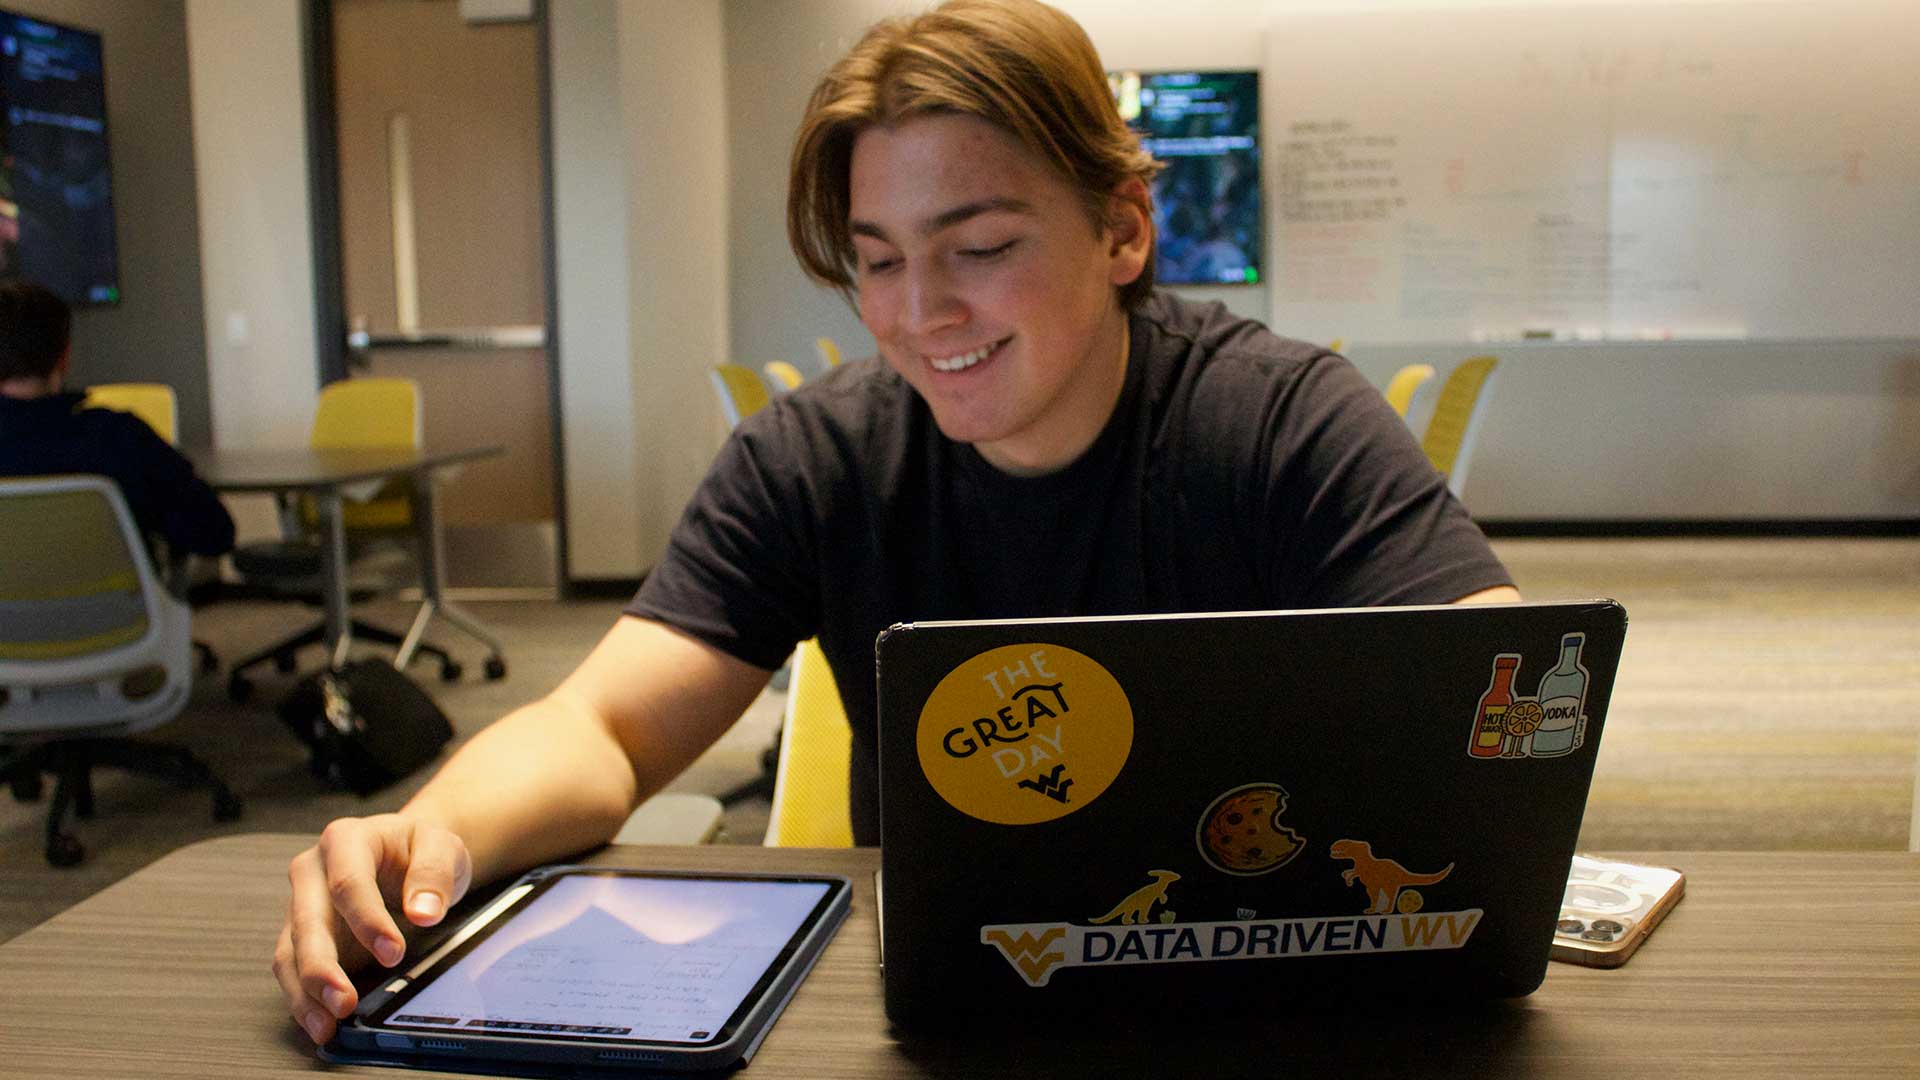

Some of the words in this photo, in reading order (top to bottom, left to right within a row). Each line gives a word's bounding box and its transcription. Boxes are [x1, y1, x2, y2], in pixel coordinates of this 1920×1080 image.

[983, 651, 1056, 699] THE
[943, 682, 1069, 758] GREAT
[1483, 713, 1505, 725] HOT
[992, 725, 1064, 778] DAY
[1083, 928, 1202, 963] DATA
[1211, 918, 1389, 957] DRIVEN
[1401, 912, 1477, 947] WV
